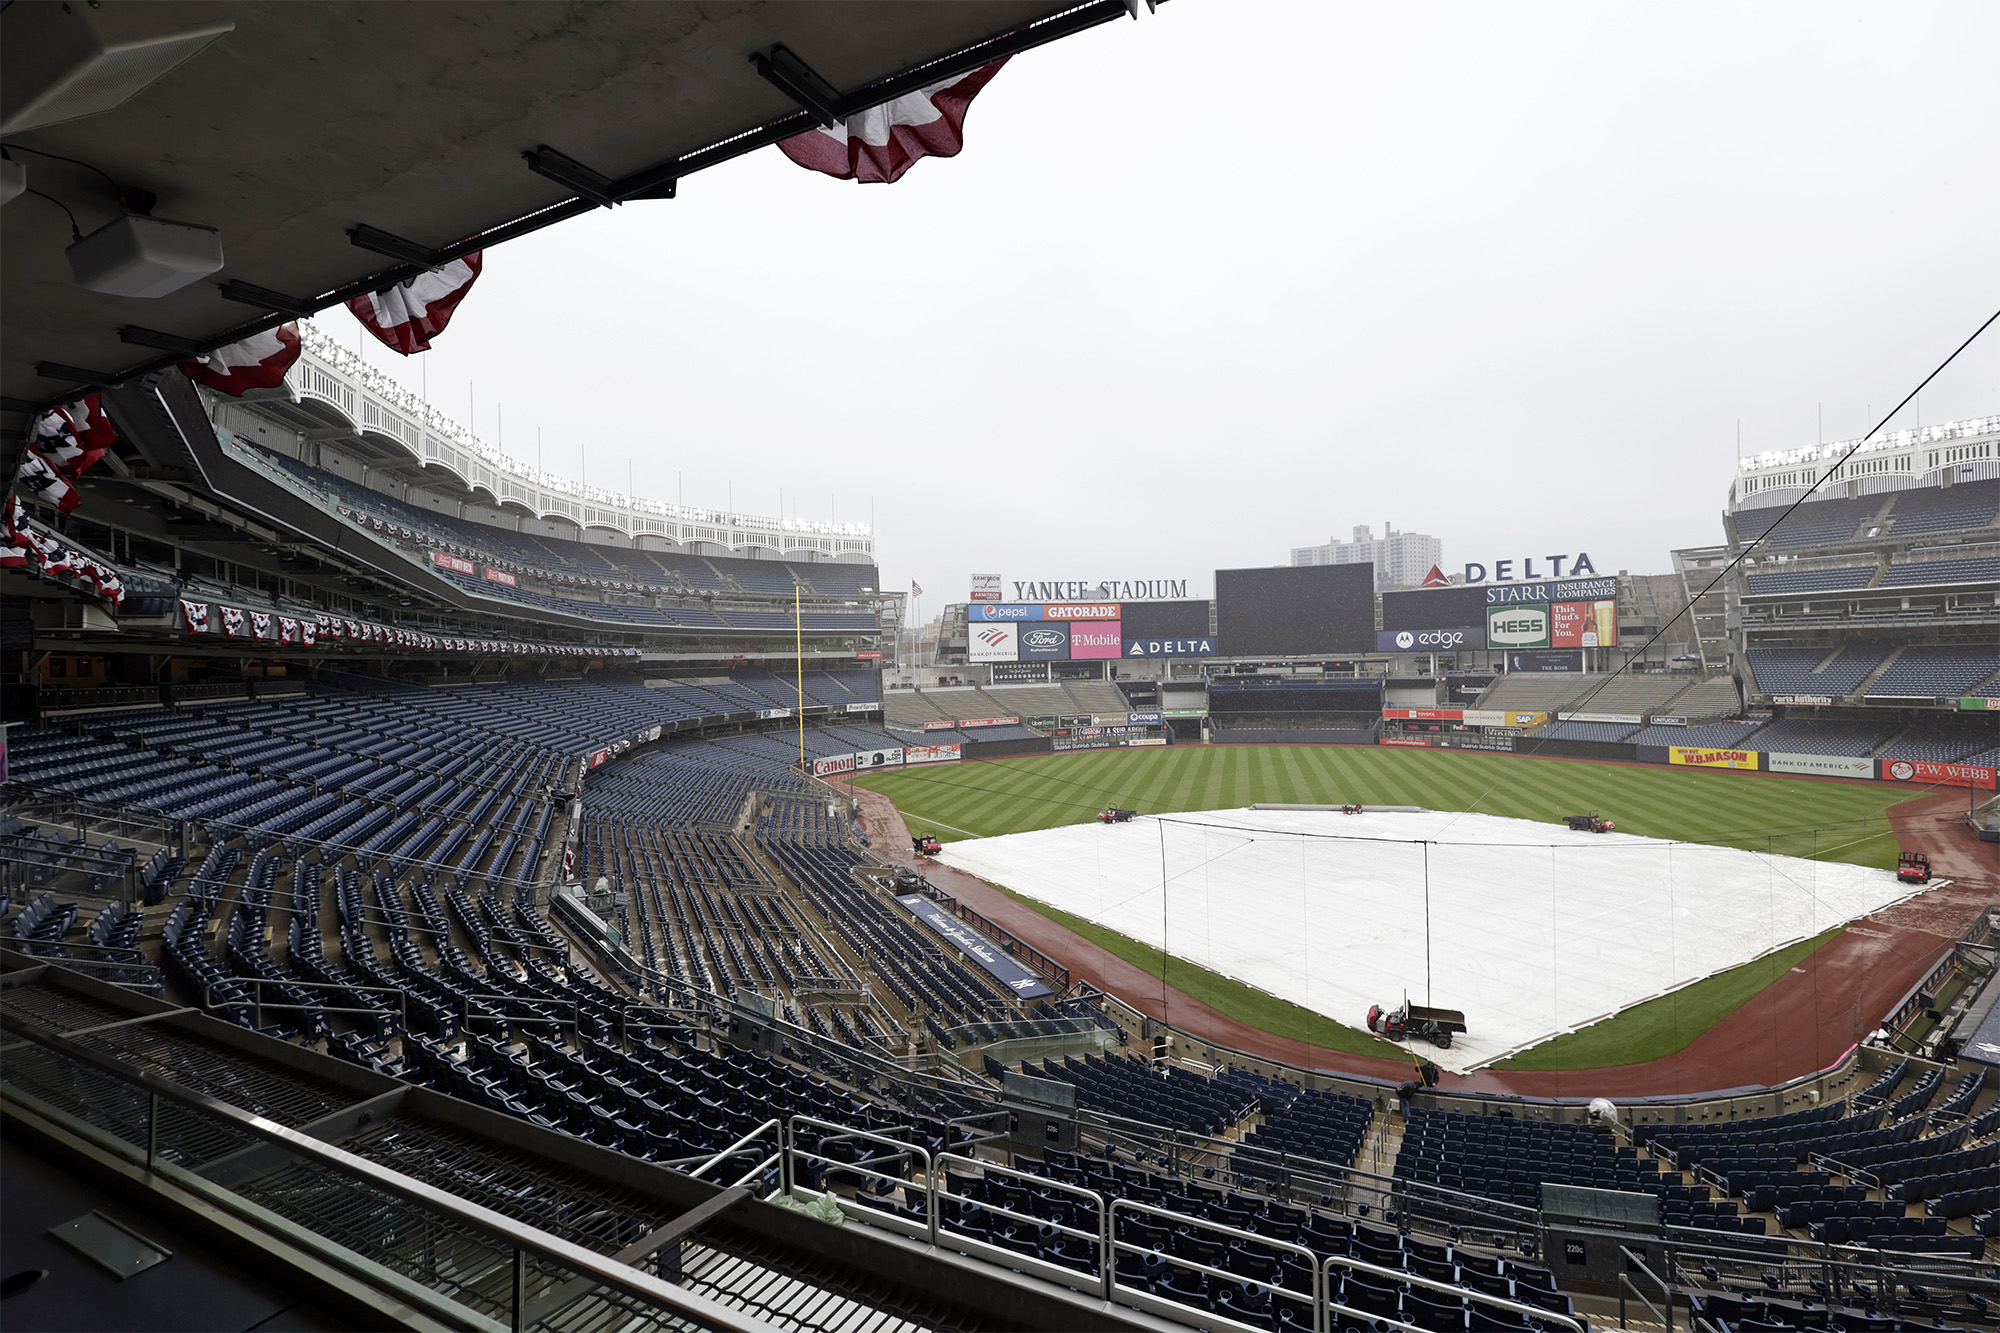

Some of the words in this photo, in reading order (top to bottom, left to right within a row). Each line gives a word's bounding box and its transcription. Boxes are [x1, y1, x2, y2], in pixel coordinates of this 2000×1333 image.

[463, 562, 473, 573] DECK
[1465, 552, 1596, 583] DELTA
[1013, 581, 1088, 600] YANKEE
[1099, 579, 1187, 600] STADIUM
[1556, 579, 1616, 591] INSURANCE
[1486, 584, 1548, 603] STARR
[1556, 587, 1616, 599] COMPANIES
[998, 607, 1027, 618] pepsi
[1048, 606, 1116, 618] GATORADE
[1554, 605, 1575, 613] This
[1554, 613, 1579, 621] Bud's
[1494, 619, 1543, 633] HESS
[1030, 632, 1058, 645] Ford
[1083, 634, 1120, 646] Mobile
[1419, 630, 1463, 649] edge
[1149, 640, 1211, 653] DELTA
[1794, 695, 1832, 703] Authority
[595, 752, 605, 766] AVIS
[814, 757, 854, 775] Canon
[1809, 762, 1850, 770] AMERICA
[1916, 763, 1942, 776] F.W.
[1946, 766, 1990, 780] WEBB
[1566, 1244, 1584, 1254] 220c
